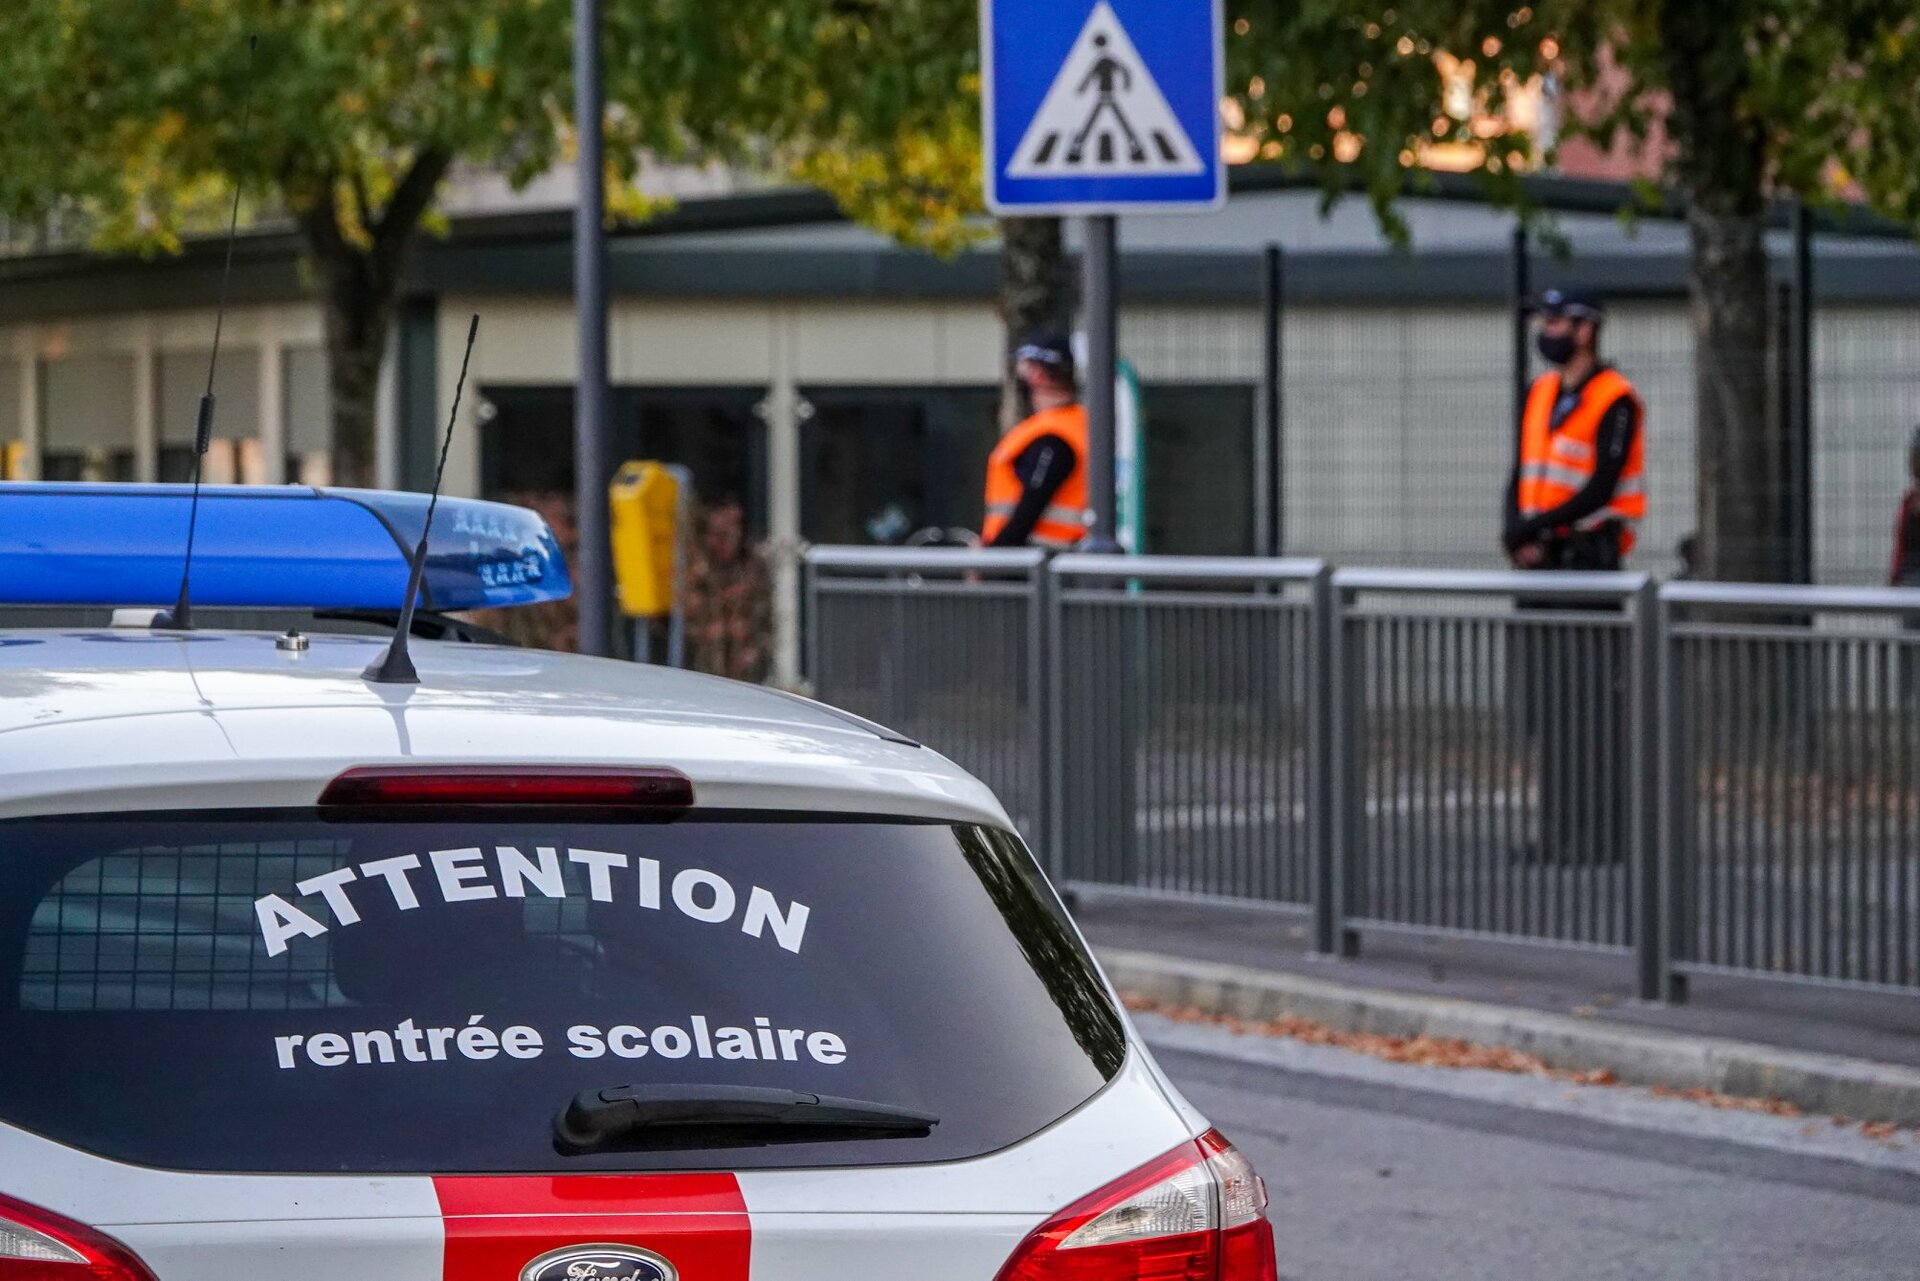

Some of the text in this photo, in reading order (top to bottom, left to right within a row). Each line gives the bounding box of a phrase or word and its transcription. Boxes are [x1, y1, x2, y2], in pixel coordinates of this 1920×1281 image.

[254, 846, 811, 958] ATTENTION
[274, 1014, 847, 1069] rentrée scolaire
